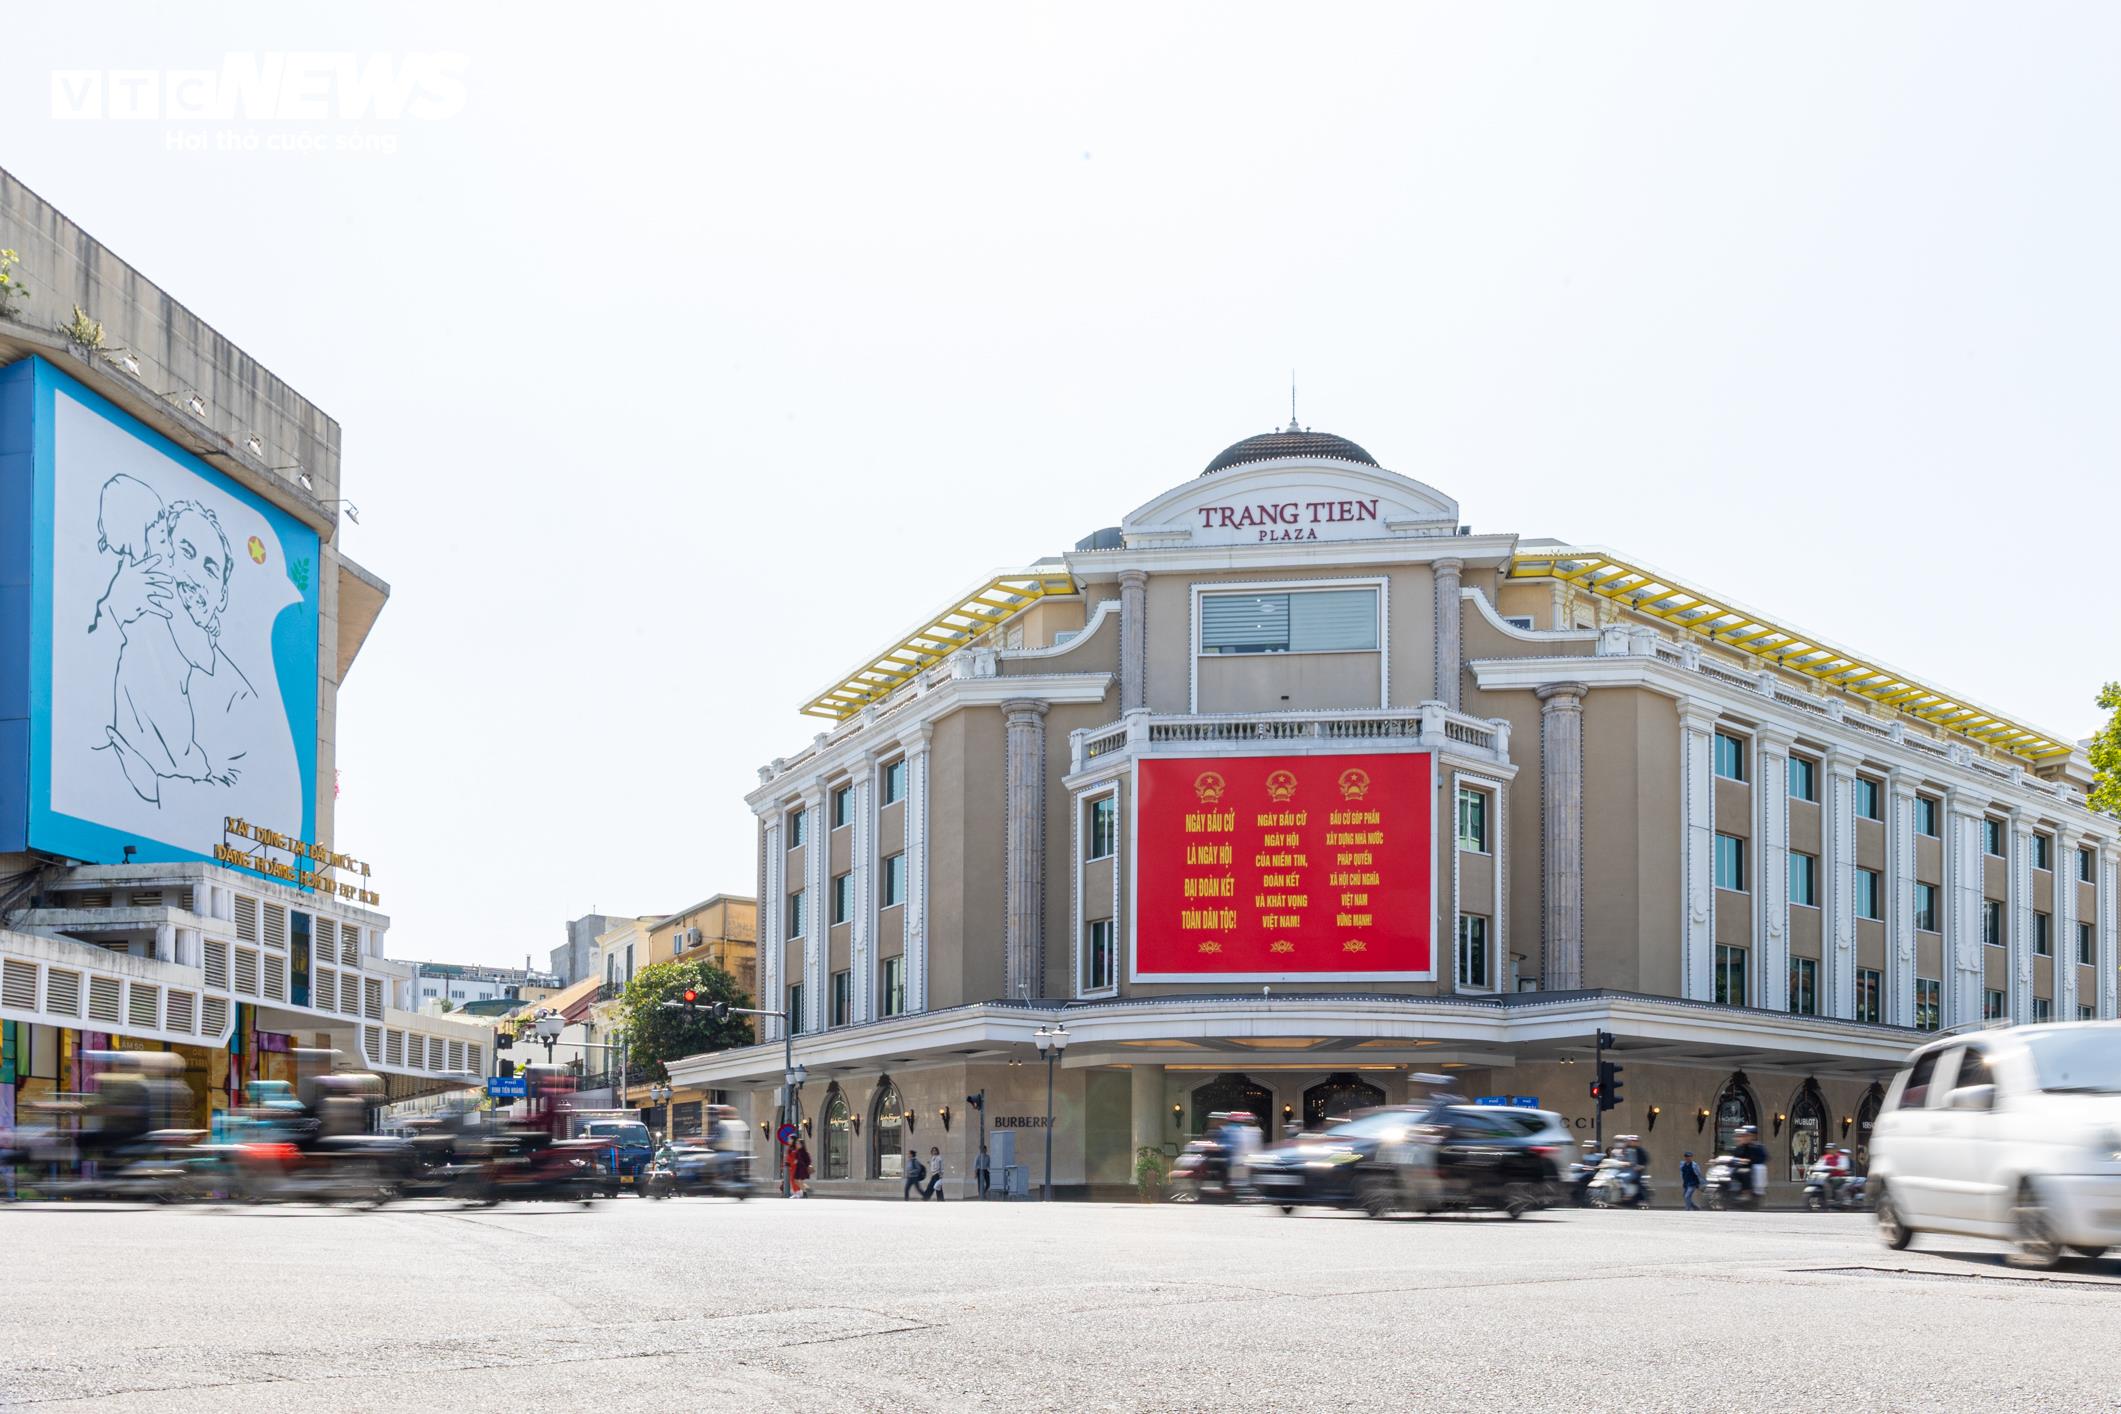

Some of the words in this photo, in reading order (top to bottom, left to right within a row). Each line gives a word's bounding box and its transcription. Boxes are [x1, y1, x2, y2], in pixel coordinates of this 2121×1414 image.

[1199, 502, 1299, 530] TRANG
[1306, 499, 1379, 523] TIEN
[1259, 528, 1318, 541] PLAZA
[1185, 810, 1206, 832] NGÀY
[1207, 807, 1223, 832] BẦU
[1223, 807, 1236, 832] CỬ
[1257, 811, 1278, 827] NGÀY
[1264, 831, 1285, 847] NGÀY
[1286, 831, 1299, 849] HỘI
[1187, 842, 1197, 865] LÀ
[1198, 842, 1219, 865] NGÀY
[1219, 841, 1232, 869] HỘI
[1255, 851, 1271, 867] CỦA
[1184, 878, 1197, 902] ĐẠI
[1198, 874, 1219, 897] ĐOÀN
[1220, 871, 1236, 897] KẾT
[1263, 872, 1284, 887] ĐOÀN
[1285, 870, 1300, 887] KẾT
[1255, 893, 1265, 908] VÀ
[1266, 892, 1286, 908] KHÁT
[1287, 894, 1308, 910] VỌNG
[1354, 893, 1368, 906] NAM
[1181, 906, 1201, 929] TOÀN
[1202, 906, 1218, 929] DÂN
[1220, 906, 1237, 933] TỘC!
[1262, 913, 1278, 931] VIỆT
[1280, 915, 1300, 928] NAM!
[994, 1116, 1057, 1128] BURBERRY
[1560, 1117, 1595, 1129] CCI
